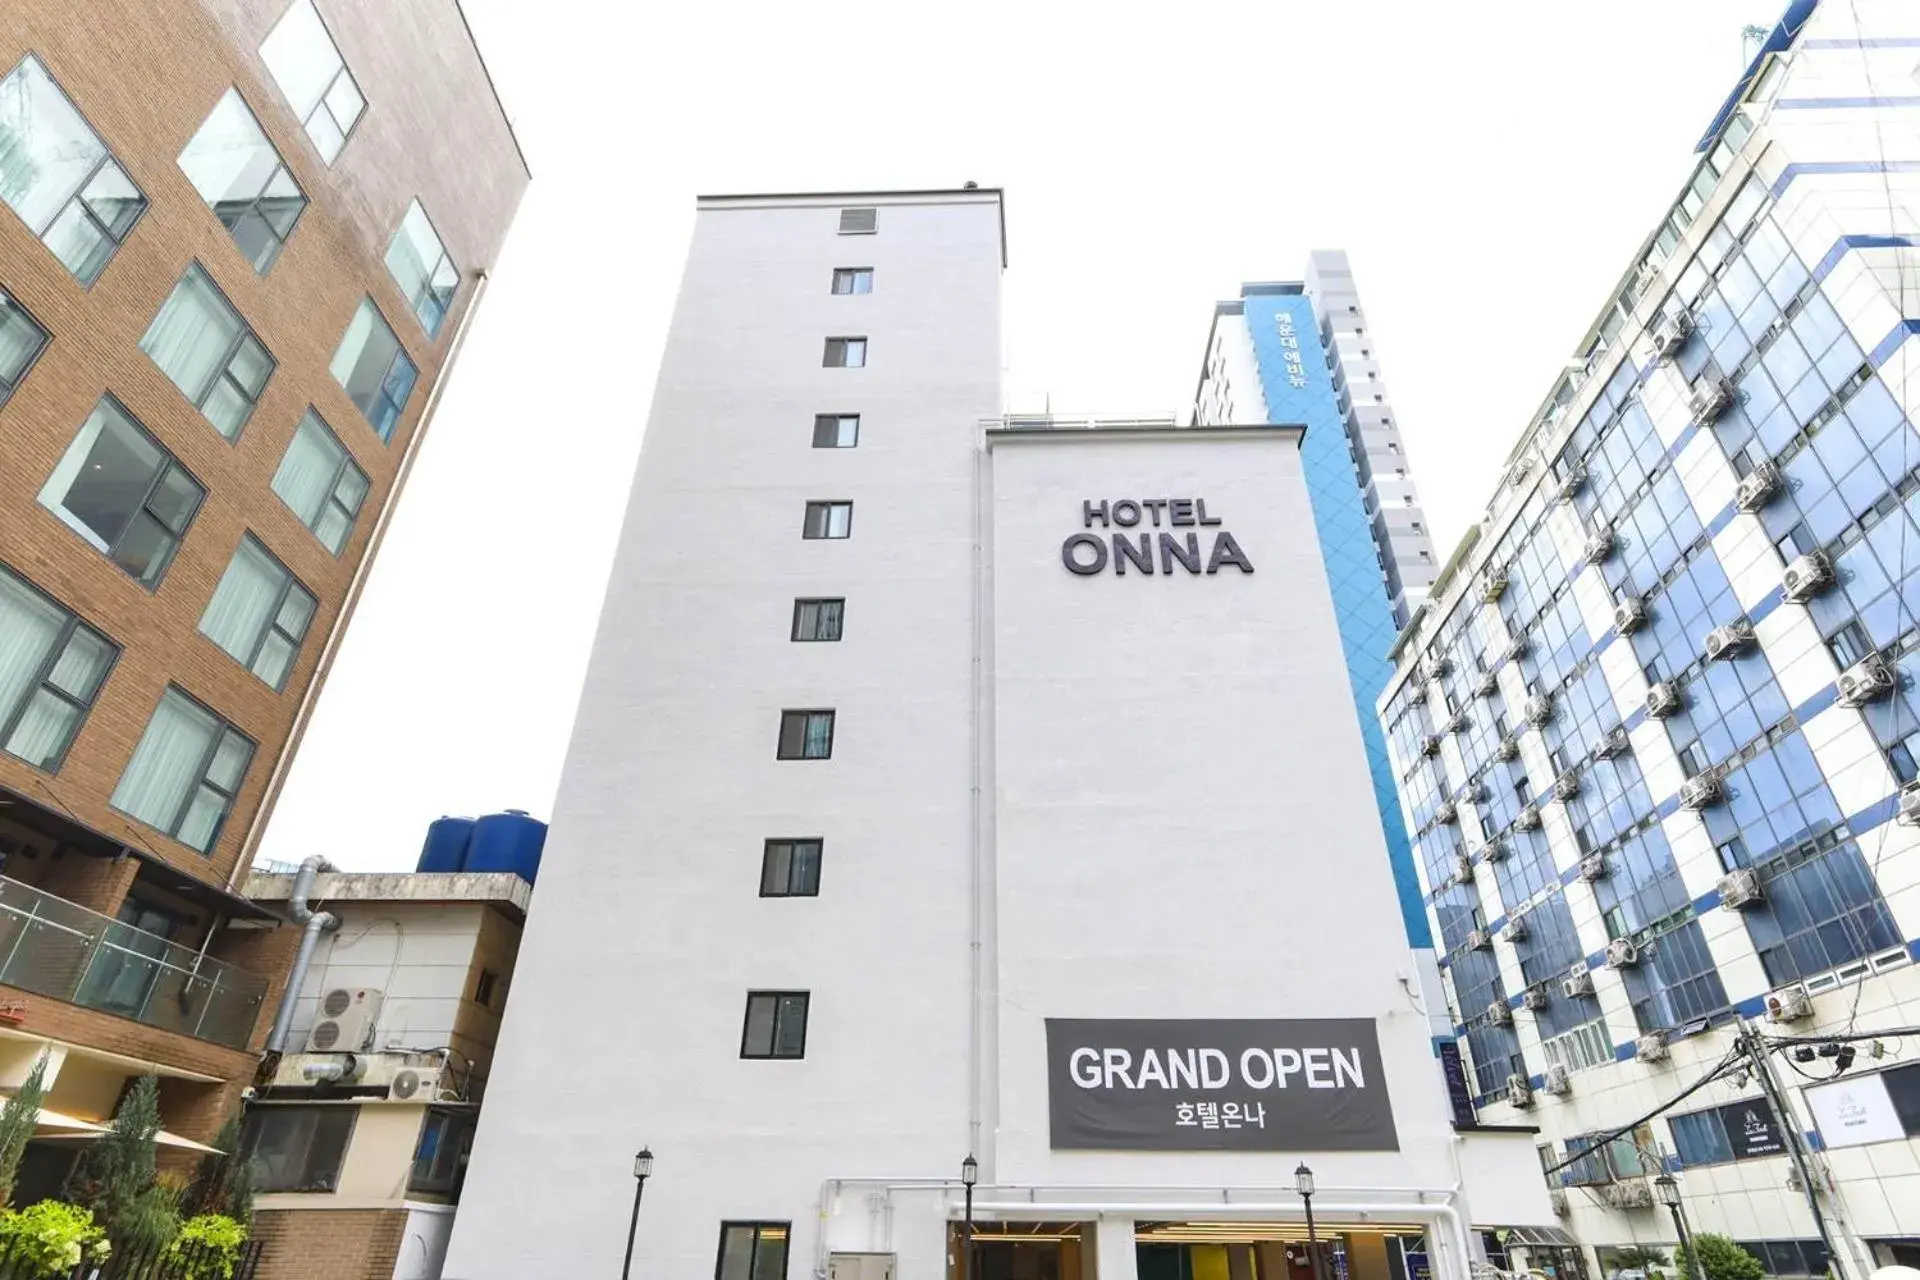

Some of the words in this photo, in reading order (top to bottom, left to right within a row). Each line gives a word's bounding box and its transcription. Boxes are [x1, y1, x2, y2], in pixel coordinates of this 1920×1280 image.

[1083, 498, 1222, 528] HOTEL
[1061, 531, 1255, 576] ONNA
[1069, 1047, 1230, 1089] GRAND
[1240, 1047, 1366, 1089] OPEN
[1175, 1101, 1266, 1129] 호텔온나
